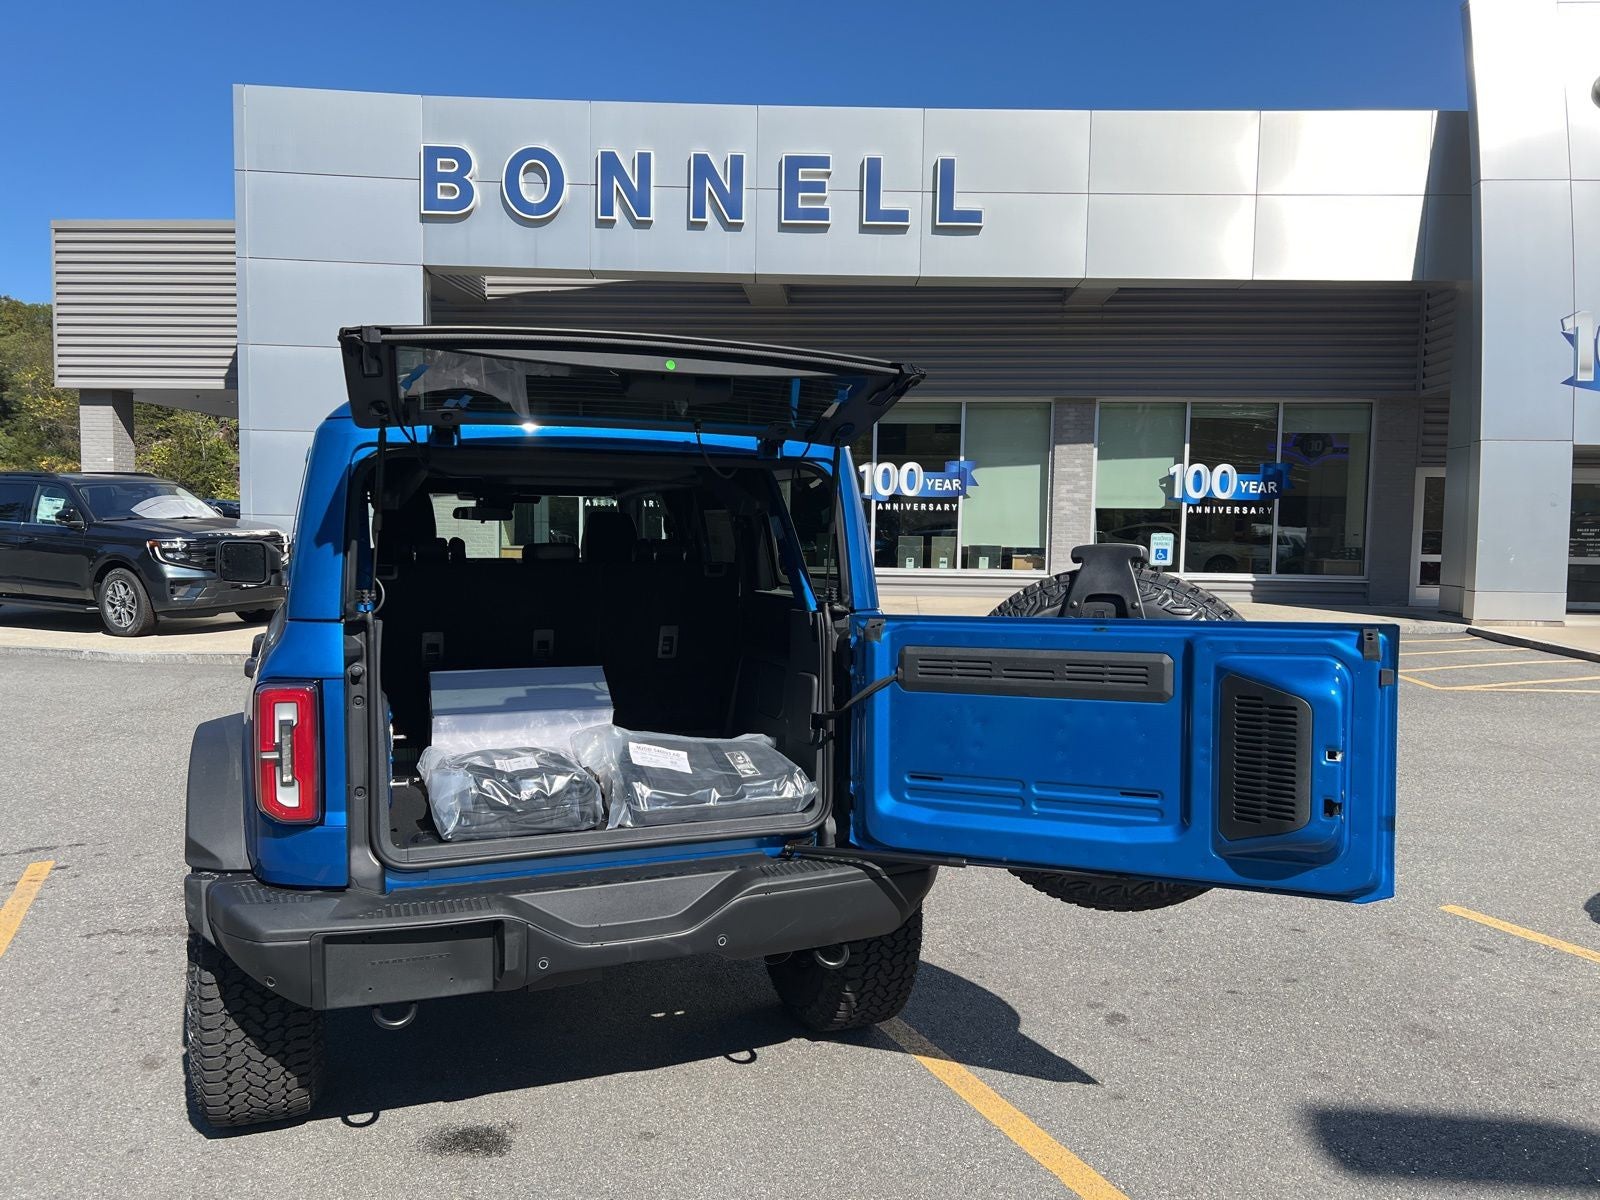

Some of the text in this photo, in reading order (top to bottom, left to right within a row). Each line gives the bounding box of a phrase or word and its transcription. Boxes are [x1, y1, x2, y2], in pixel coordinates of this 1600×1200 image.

[420, 143, 984, 228] BONNELL
[858, 461, 962, 496] 100 YEAR
[1168, 463, 1278, 500] 100 YEAR
[877, 503, 958, 511] ANNIVERSARY
[1187, 506, 1273, 514] ANNIVERSARY
